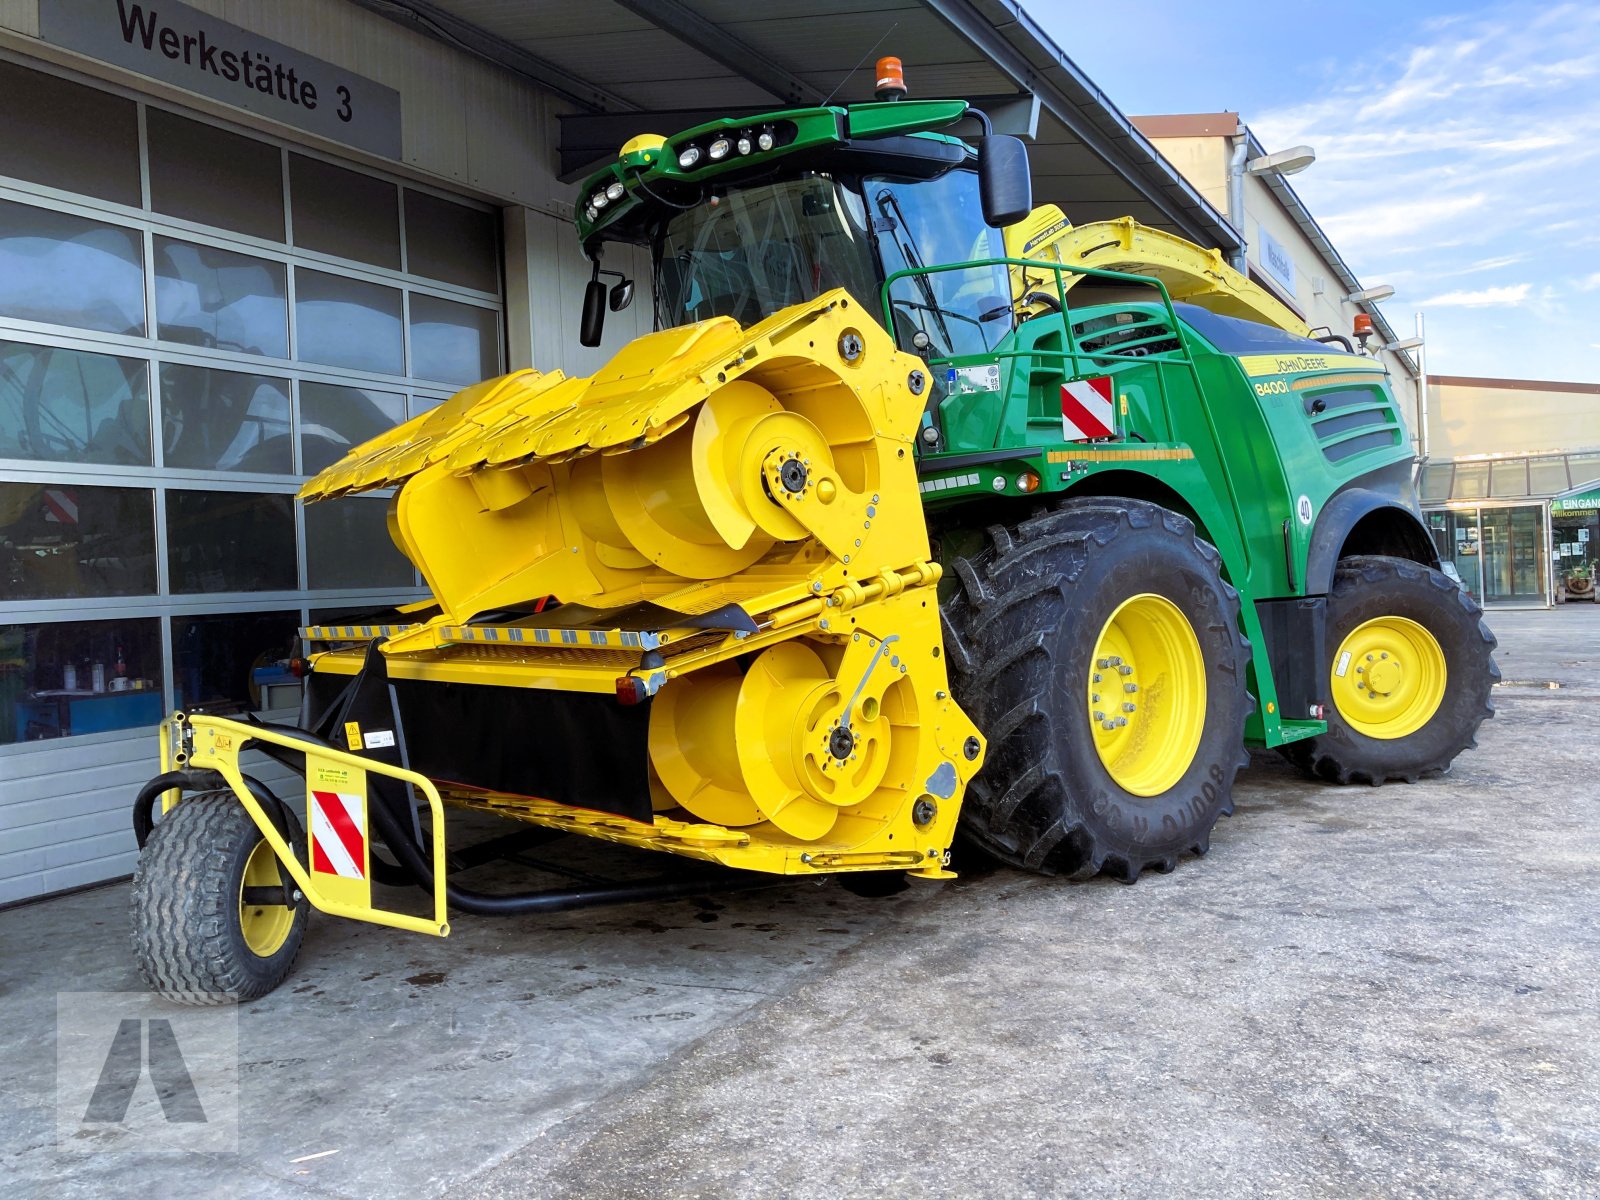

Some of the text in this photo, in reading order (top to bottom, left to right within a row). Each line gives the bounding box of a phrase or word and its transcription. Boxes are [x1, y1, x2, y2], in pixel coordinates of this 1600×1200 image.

[116, 0, 353, 123] Werkstätte 3
[1275, 356, 1328, 372] JOHN DEERE
[1254, 378, 1290, 397] 8400i
[1300, 500, 1310, 520] 40
